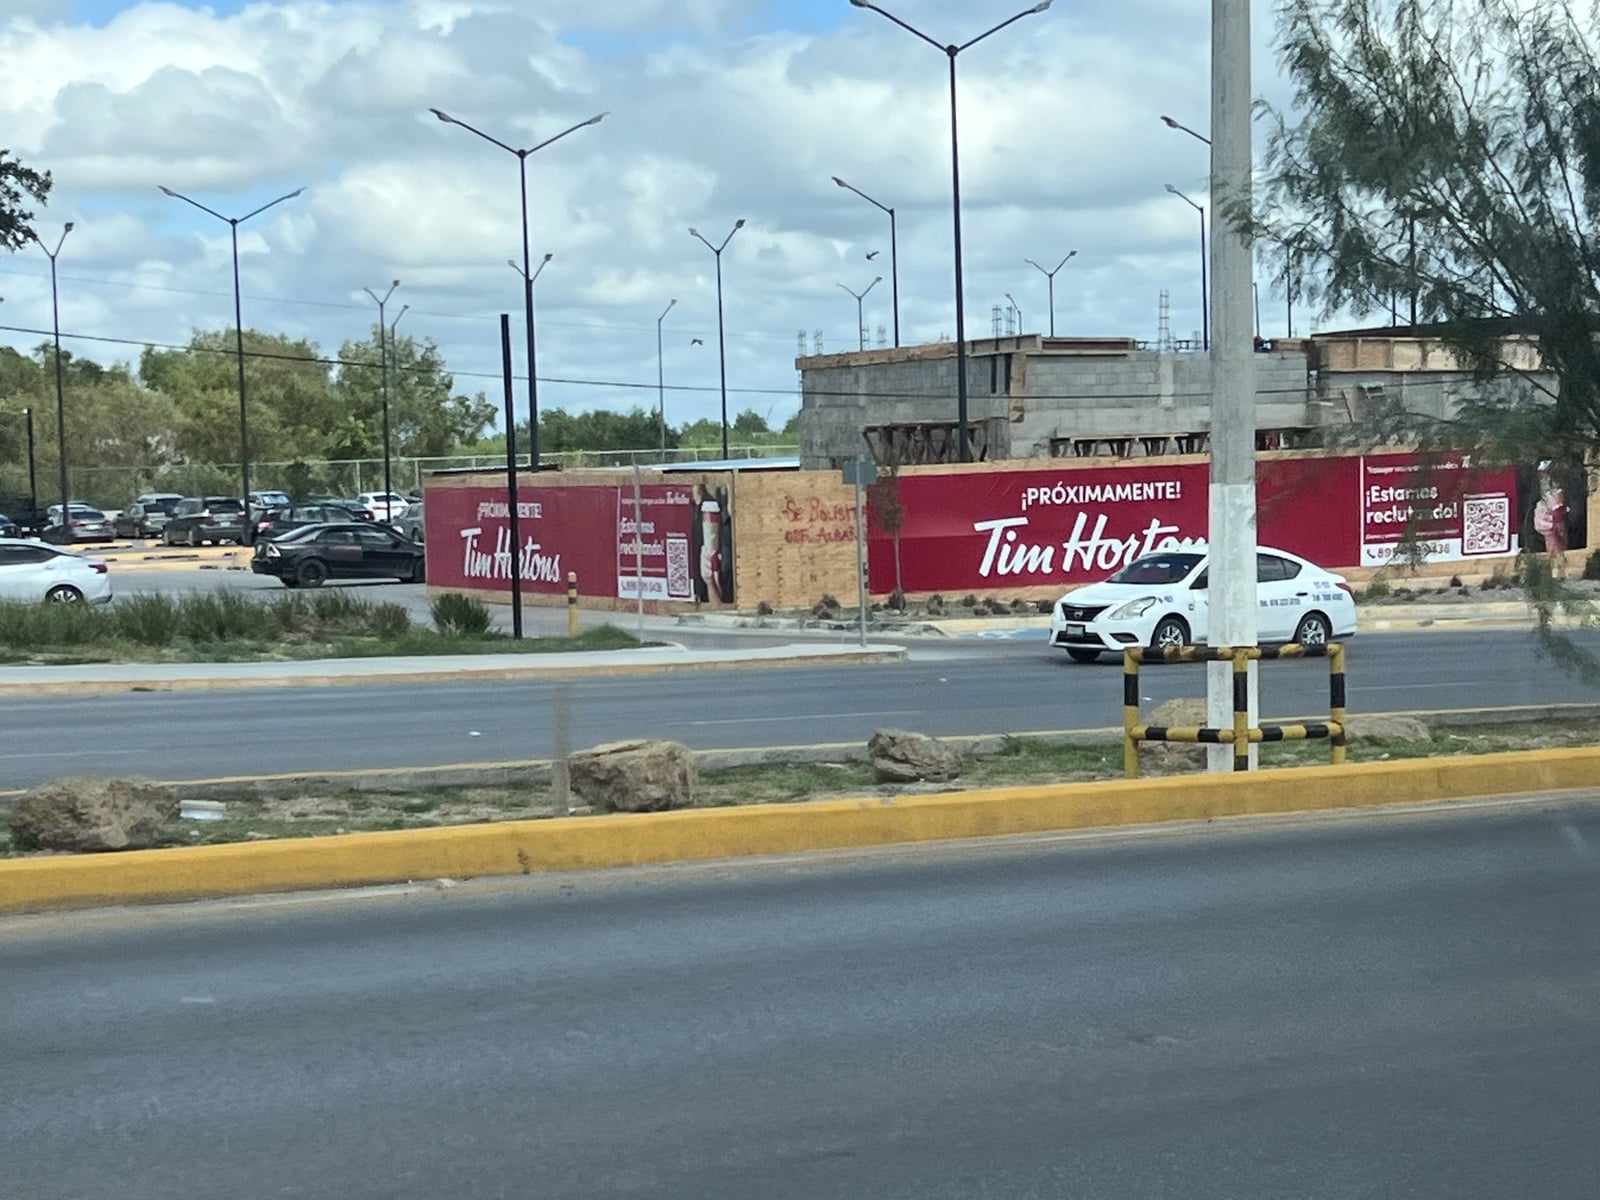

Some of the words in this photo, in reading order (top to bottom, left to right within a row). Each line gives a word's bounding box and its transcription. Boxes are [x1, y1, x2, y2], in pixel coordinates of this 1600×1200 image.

[1021, 482, 1182, 511] ¡PRÓXIMAMENTE!
[461, 527, 492, 579] Tim
[494, 525, 560, 583] Hrtons
[973, 516, 1055, 577] Tim
